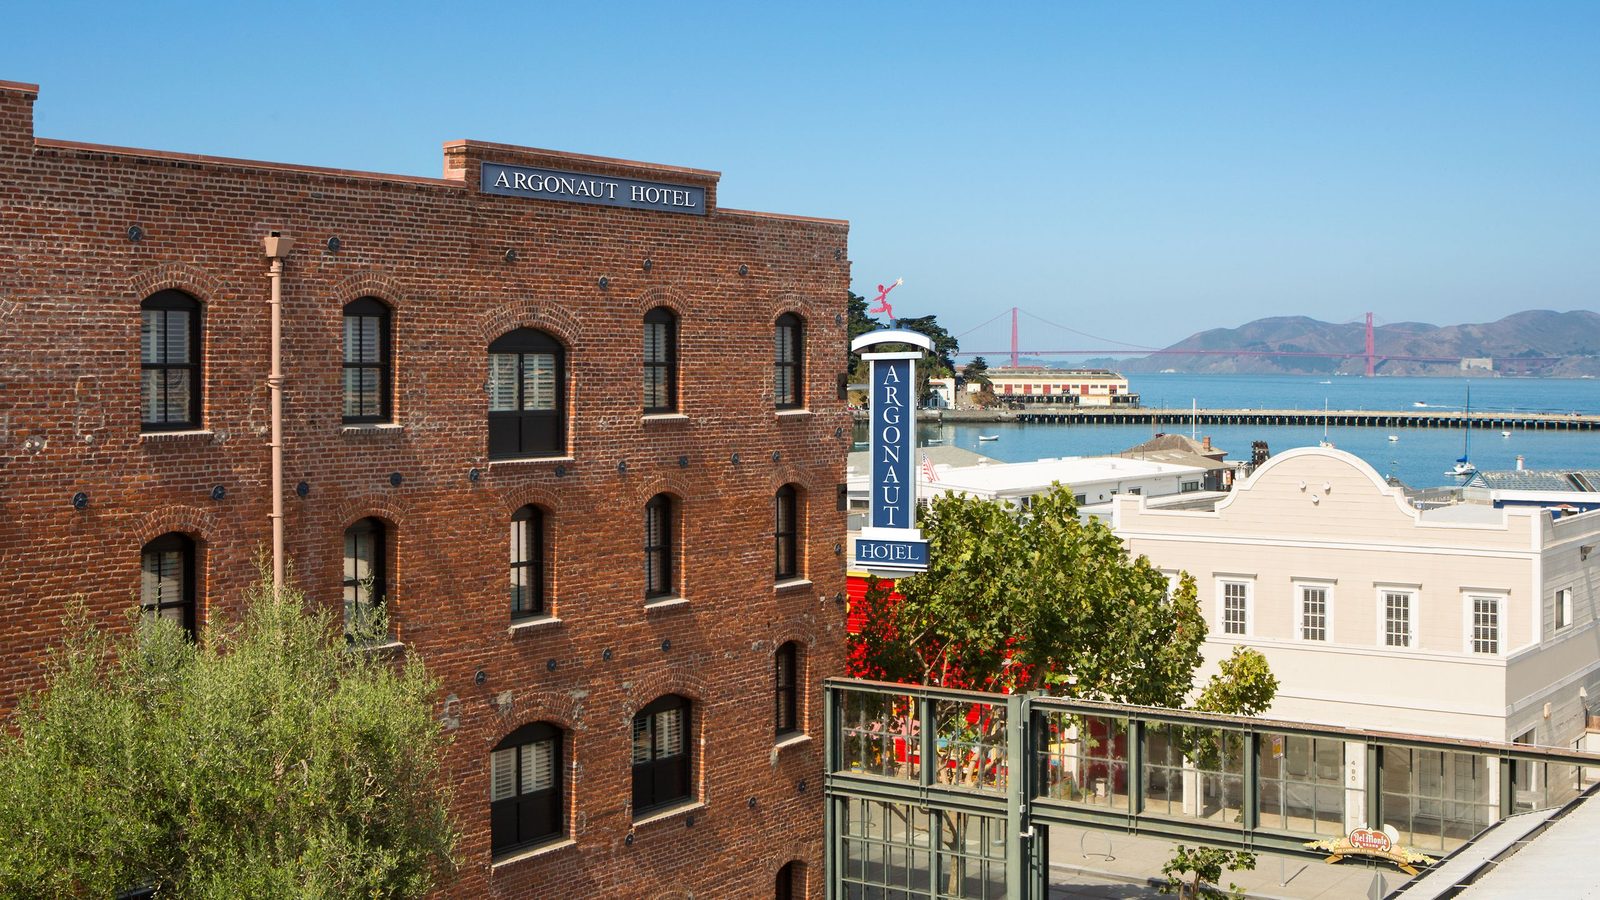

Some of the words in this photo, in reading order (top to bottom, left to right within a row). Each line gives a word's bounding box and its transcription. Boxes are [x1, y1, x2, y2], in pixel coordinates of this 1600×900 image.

[494, 171, 618, 199] ARGONAUT
[630, 185, 696, 207] HOTEL
[882, 364, 904, 526] ARGONAUT
[861, 543, 920, 561] HOTEL
